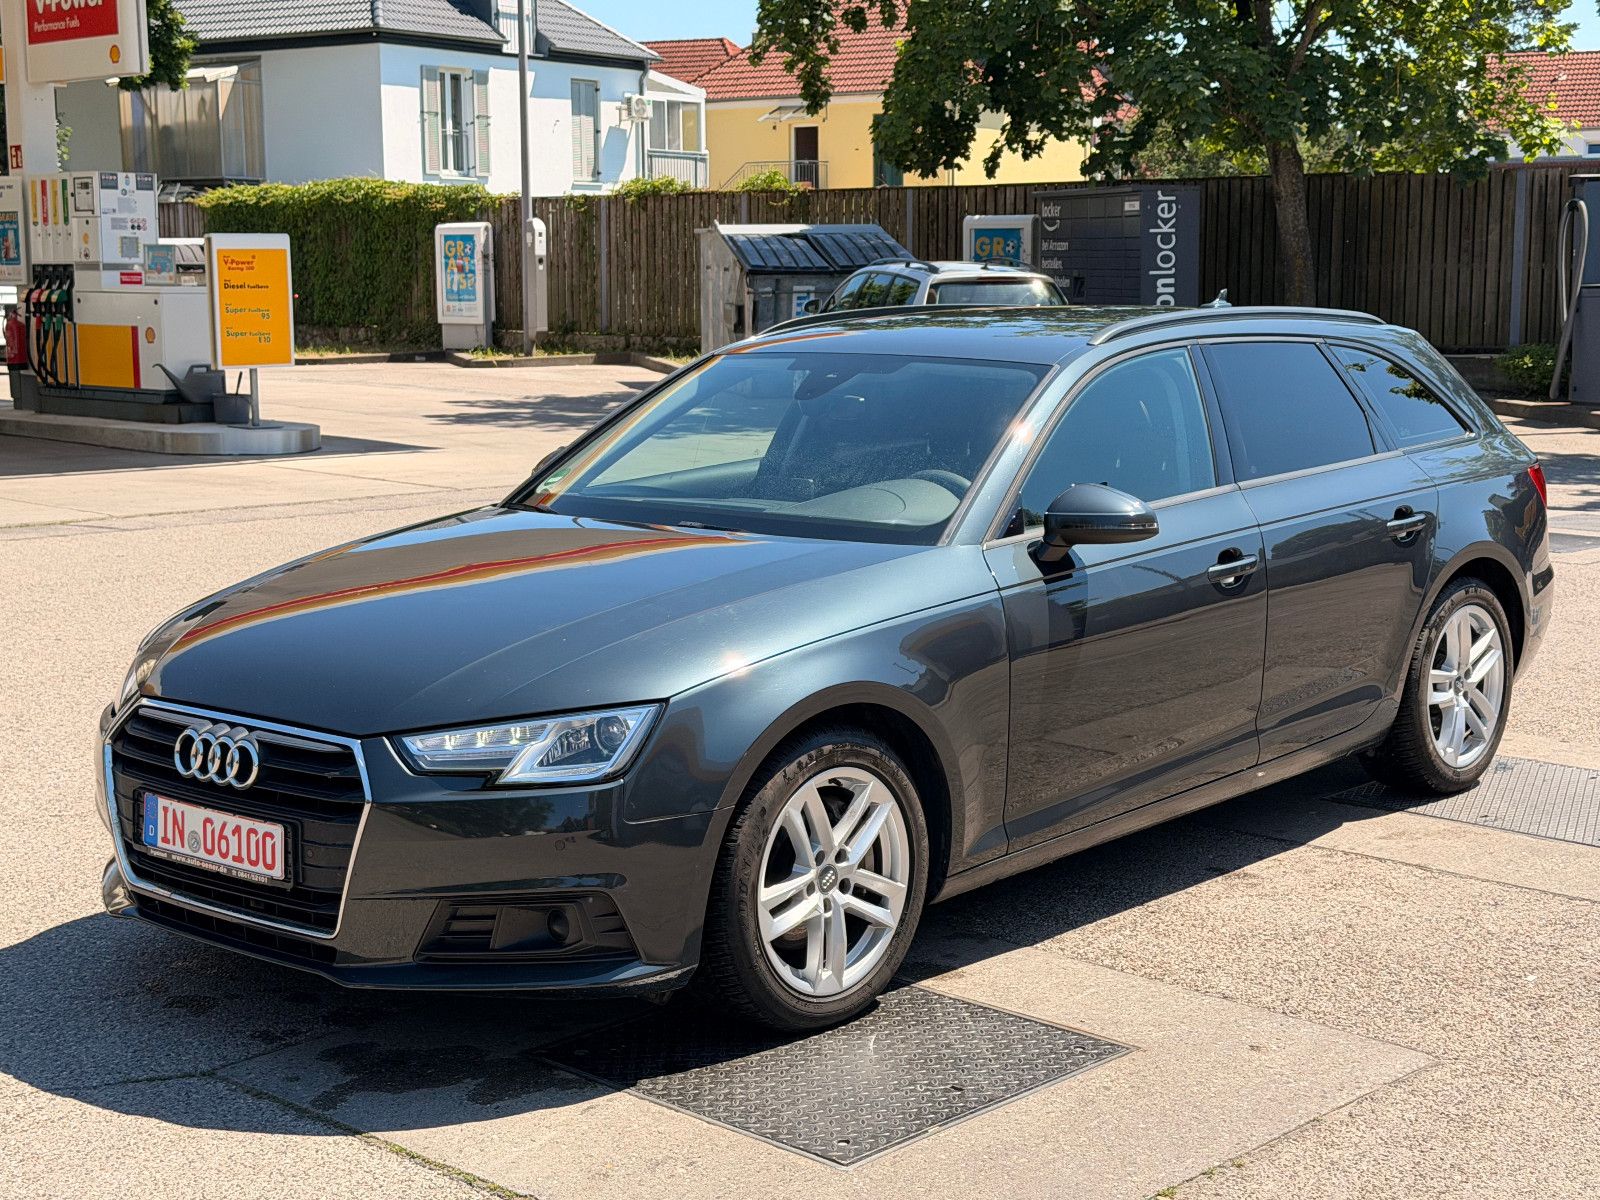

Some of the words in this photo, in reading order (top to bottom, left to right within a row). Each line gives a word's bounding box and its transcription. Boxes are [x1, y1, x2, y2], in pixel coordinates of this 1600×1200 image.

[33, 19, 66, 33] Performance
[66, 16, 80, 28] Fuels
[1041, 202, 1061, 217] locker
[1049, 240, 1069, 251] Amazon
[225, 306, 246, 315] Super
[226, 330, 248, 338] Super
[149, 825, 155, 836] D
[161, 805, 185, 849] IN
[202, 816, 276, 871] 06100
